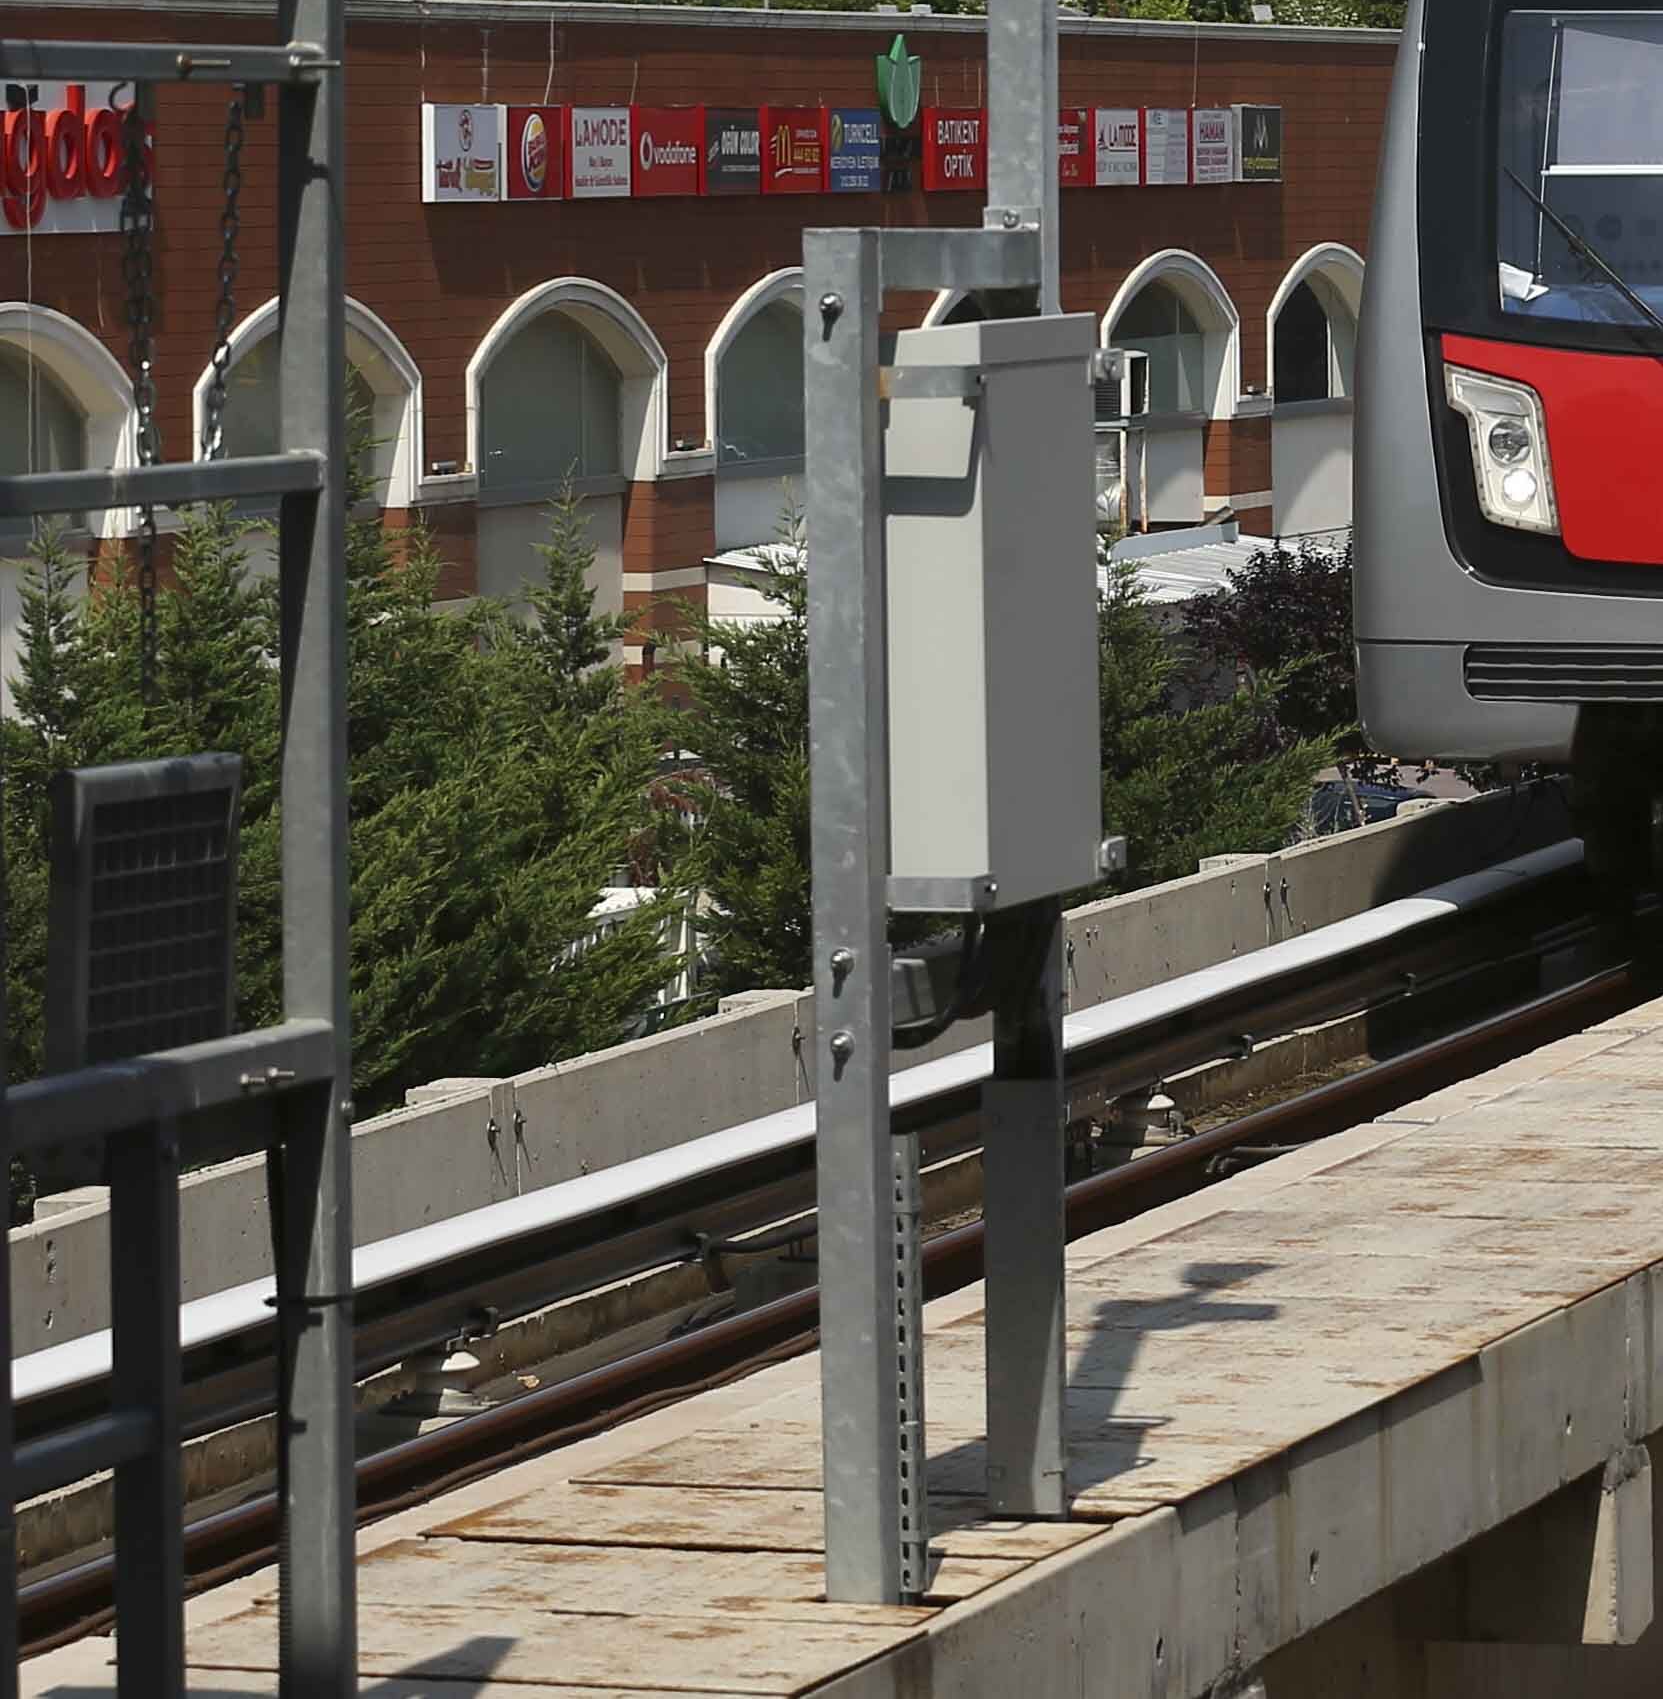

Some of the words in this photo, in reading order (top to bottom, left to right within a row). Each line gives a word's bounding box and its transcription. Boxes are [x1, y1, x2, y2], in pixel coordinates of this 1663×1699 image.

[938, 120, 979, 144] BATIKENT
[653, 140, 697, 164] vodafone
[944, 148, 974, 177] OPTİK
